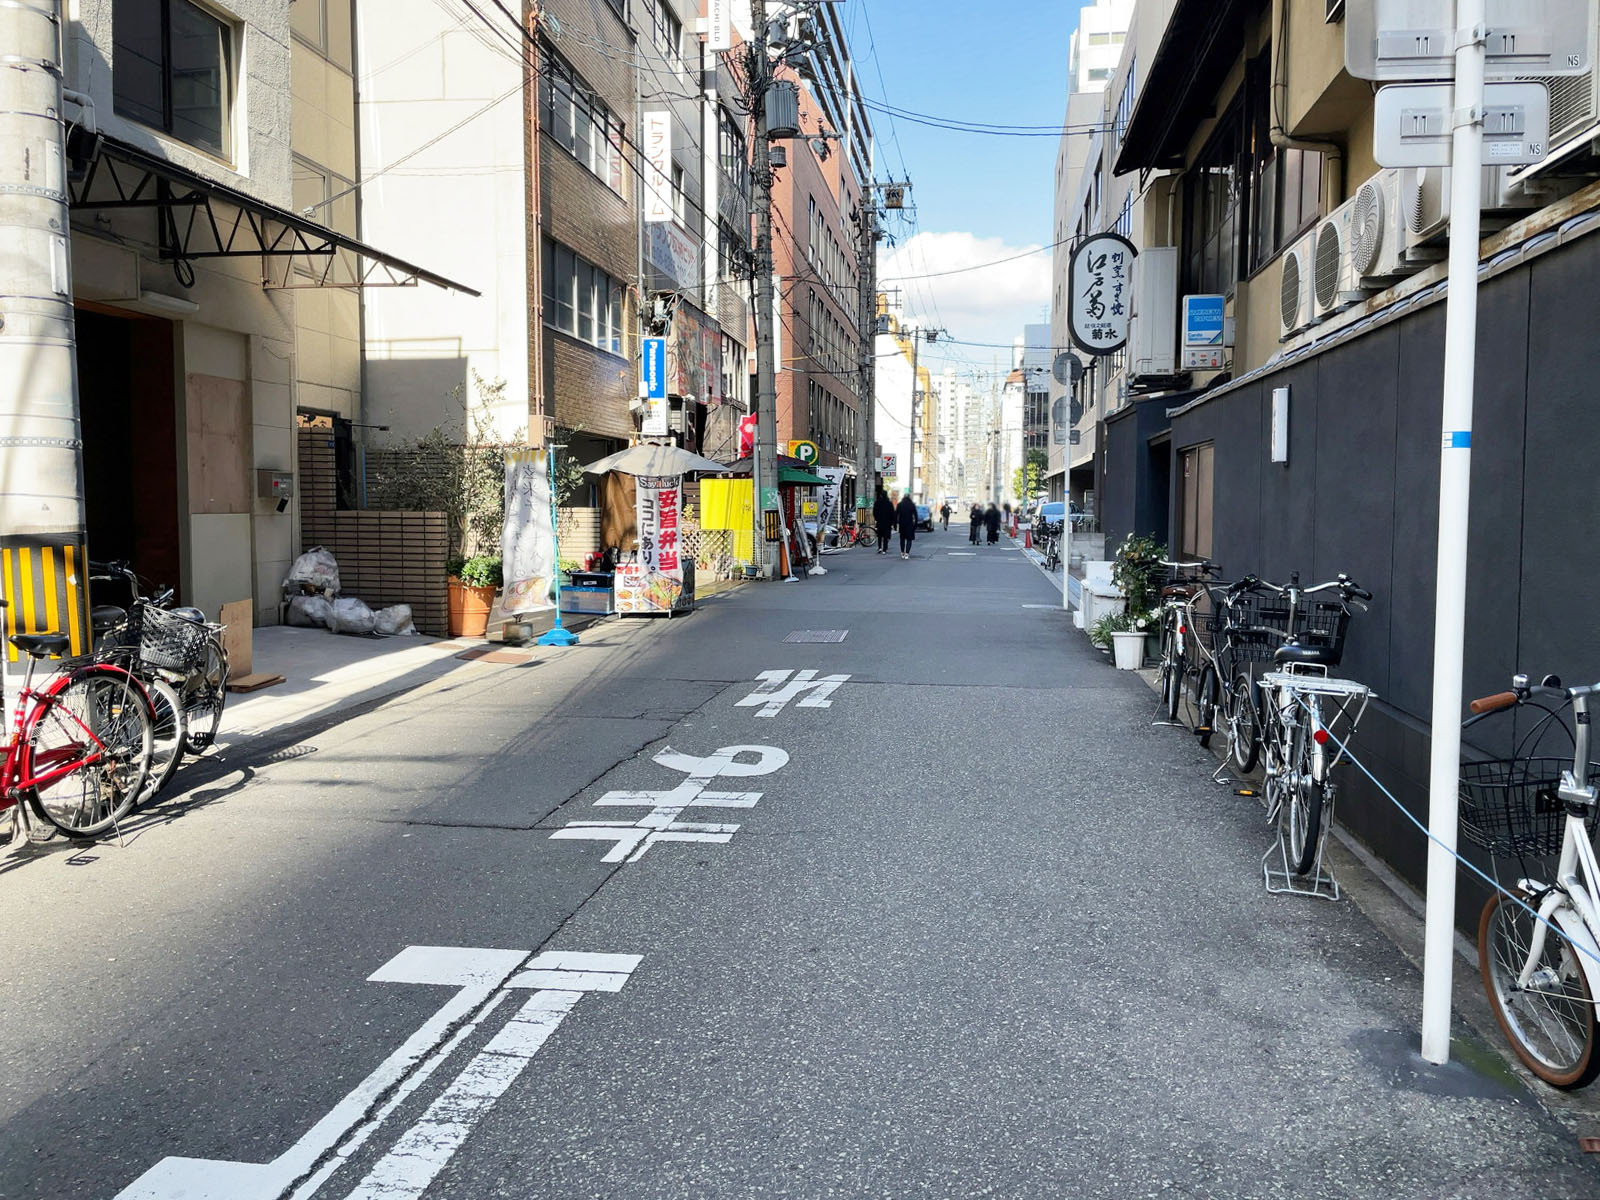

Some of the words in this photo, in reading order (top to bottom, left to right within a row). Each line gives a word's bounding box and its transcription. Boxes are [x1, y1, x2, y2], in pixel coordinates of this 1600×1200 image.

[1567, 55, 1579, 66] NS
[1529, 143, 1540, 154] NS
[649, 341, 659, 392] Panasonic
[800, 446, 813, 461] P
